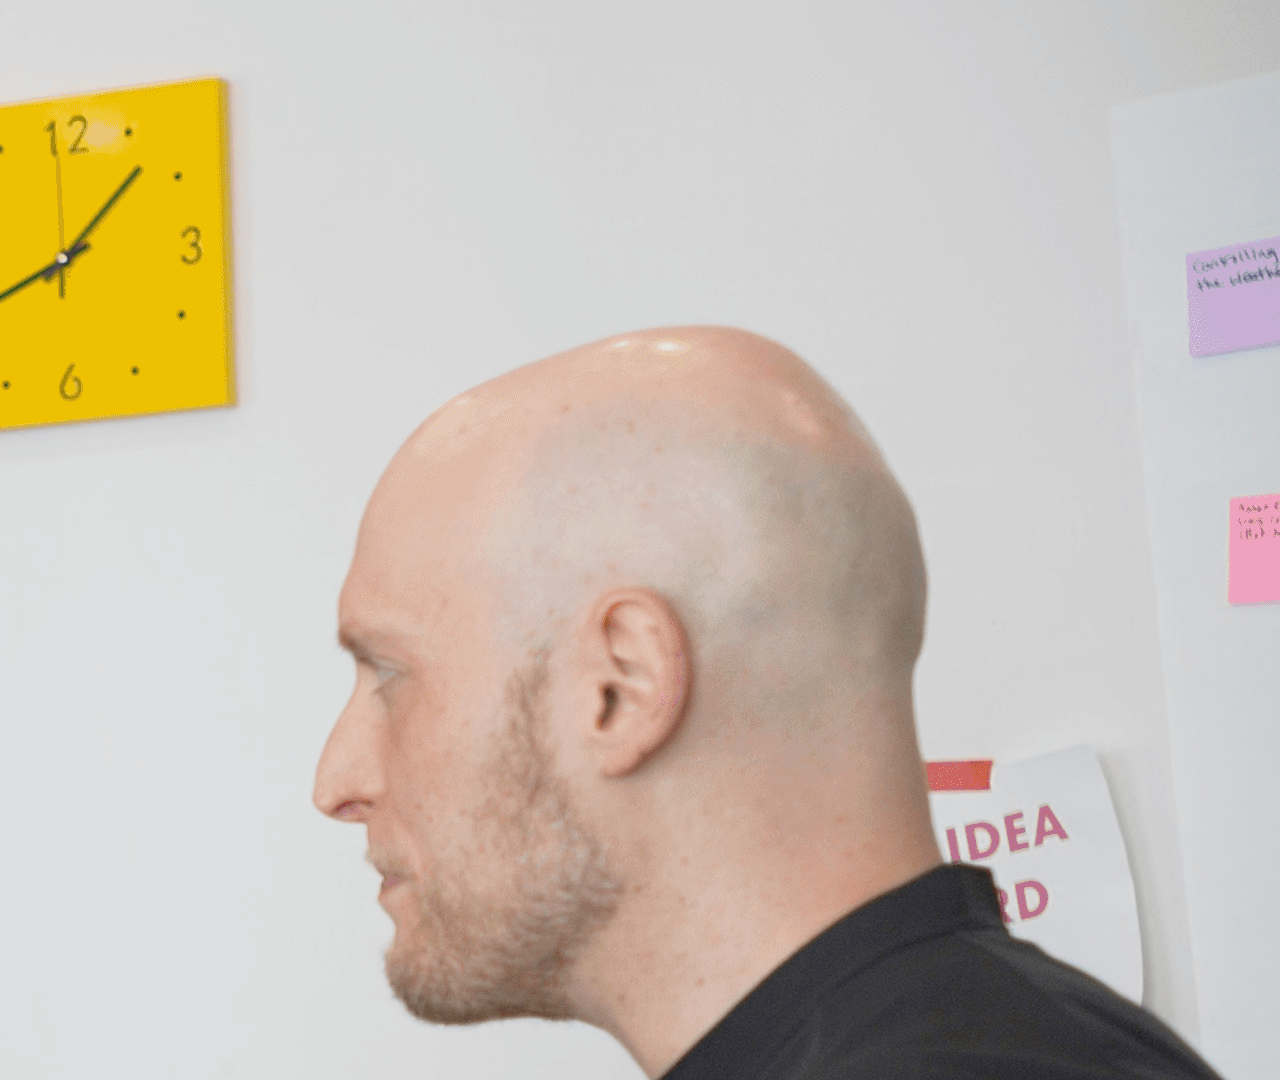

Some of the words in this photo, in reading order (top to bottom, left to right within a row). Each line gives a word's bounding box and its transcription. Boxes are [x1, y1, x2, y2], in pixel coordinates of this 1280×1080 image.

[44, 114, 90, 156] 12
[180, 225, 203, 266] 3
[59, 361, 83, 401] 6
[946, 803, 1069, 864] IDEA
